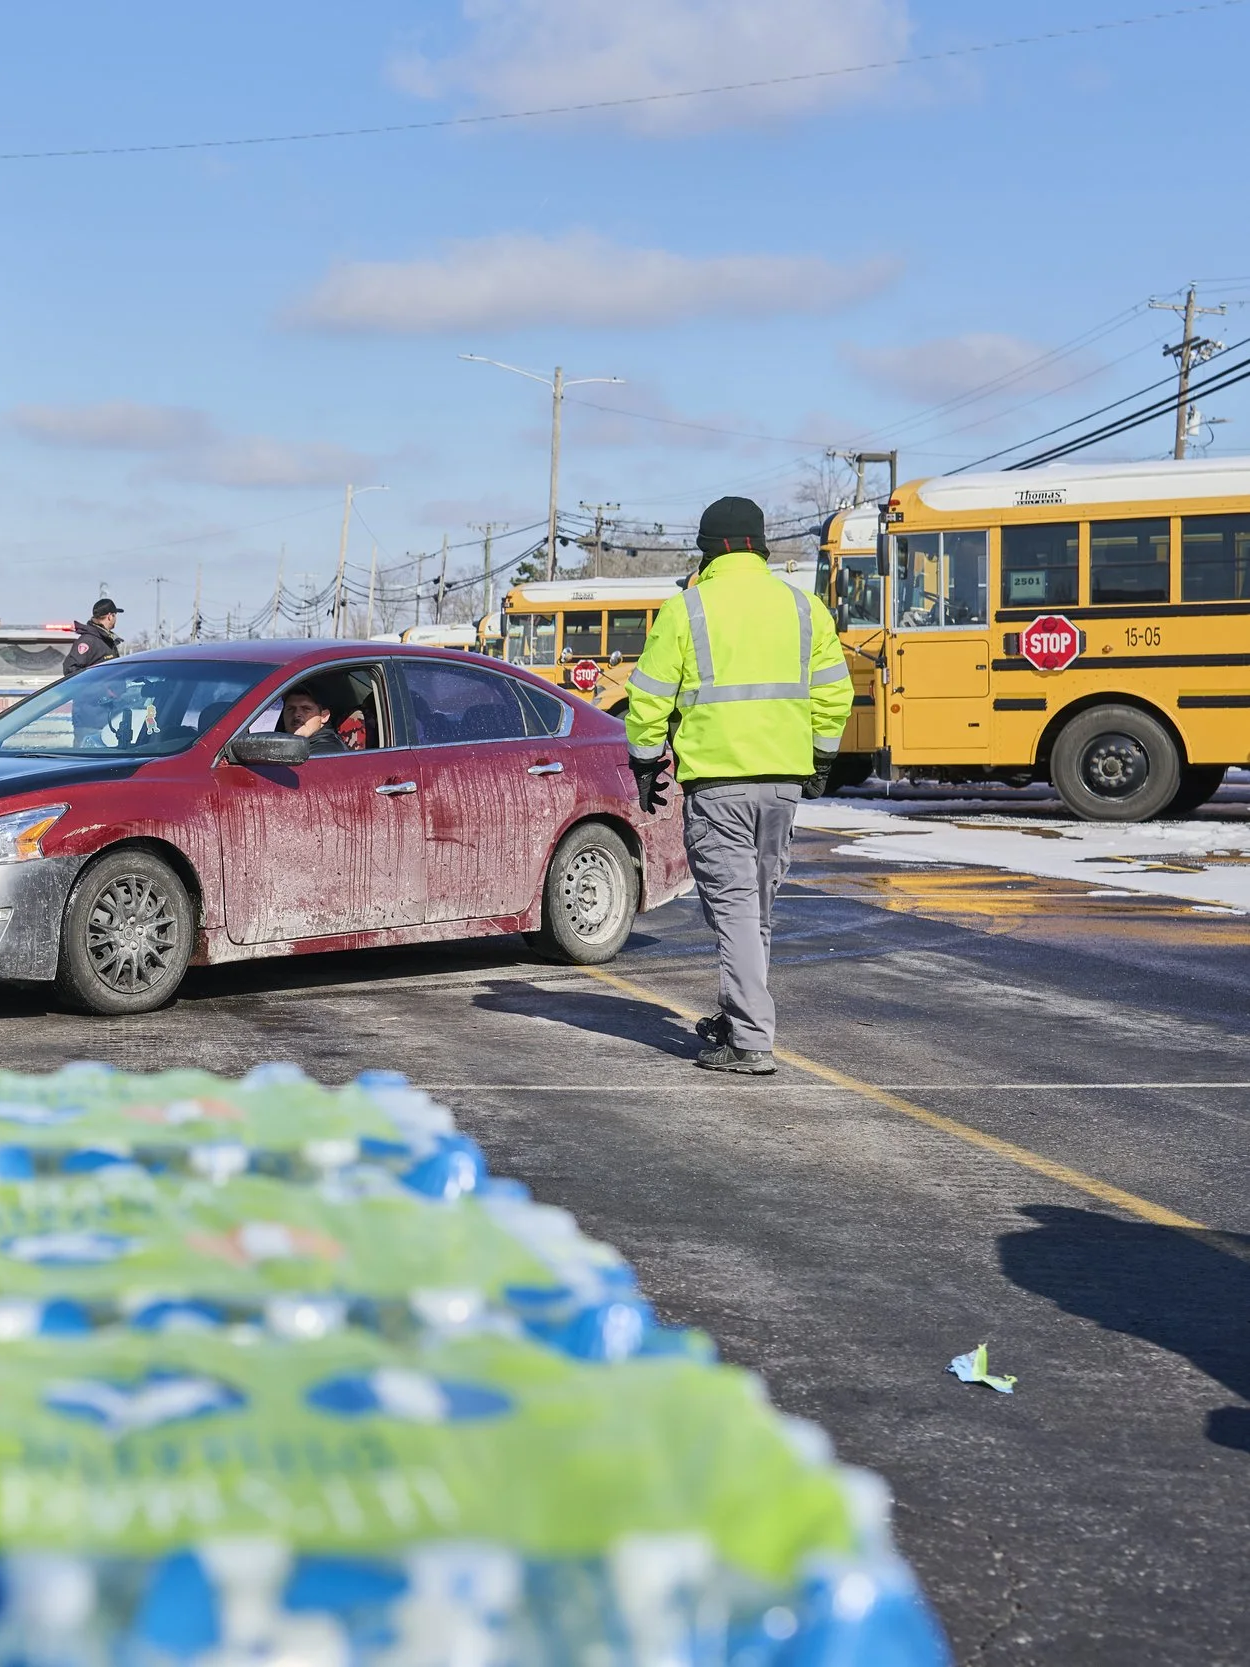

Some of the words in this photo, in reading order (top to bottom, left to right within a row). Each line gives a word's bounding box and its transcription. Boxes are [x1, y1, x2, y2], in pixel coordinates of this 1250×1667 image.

[1017, 490, 1063, 500] Thomas
[1014, 577, 1041, 586] 2501
[1124, 627, 1161, 647] 15-05
[1030, 632, 1071, 654] STOP
[576, 669, 596, 680] STOP
